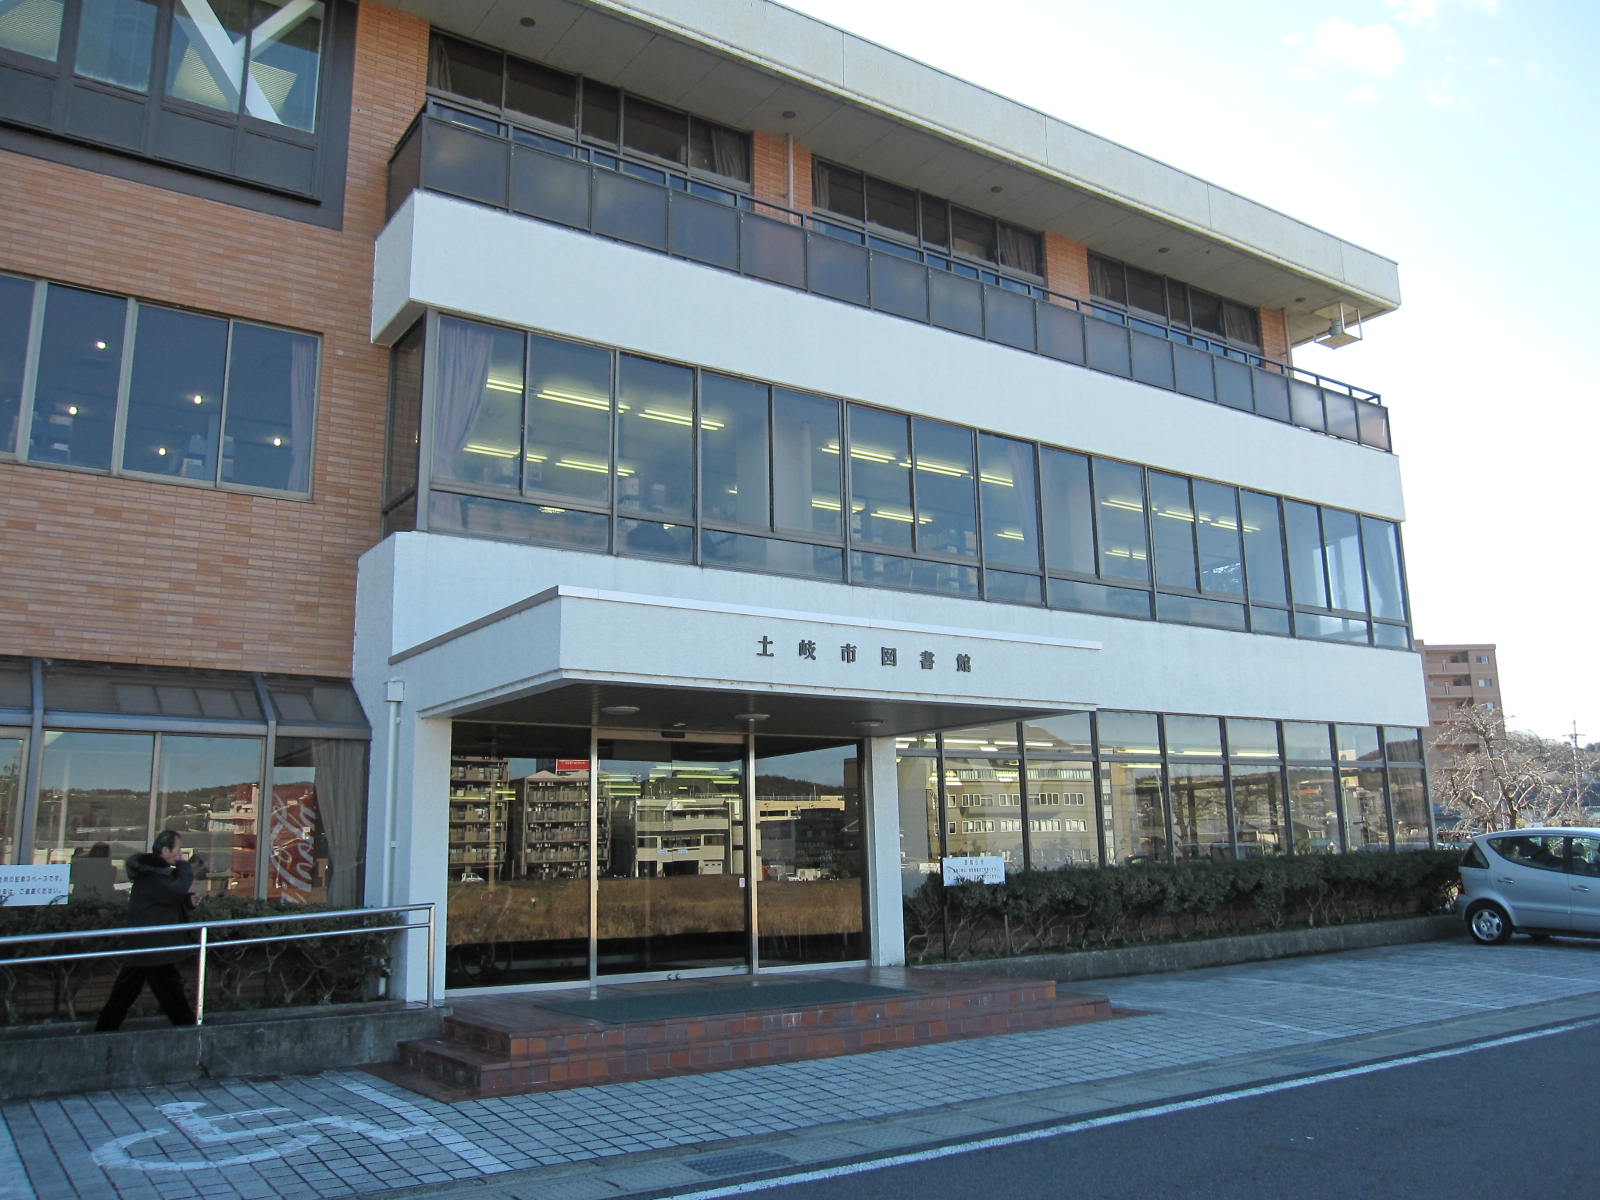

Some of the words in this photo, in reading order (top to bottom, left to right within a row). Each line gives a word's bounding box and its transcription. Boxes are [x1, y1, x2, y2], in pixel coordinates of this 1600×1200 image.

[756, 635, 972, 673] 土岐市図書館
